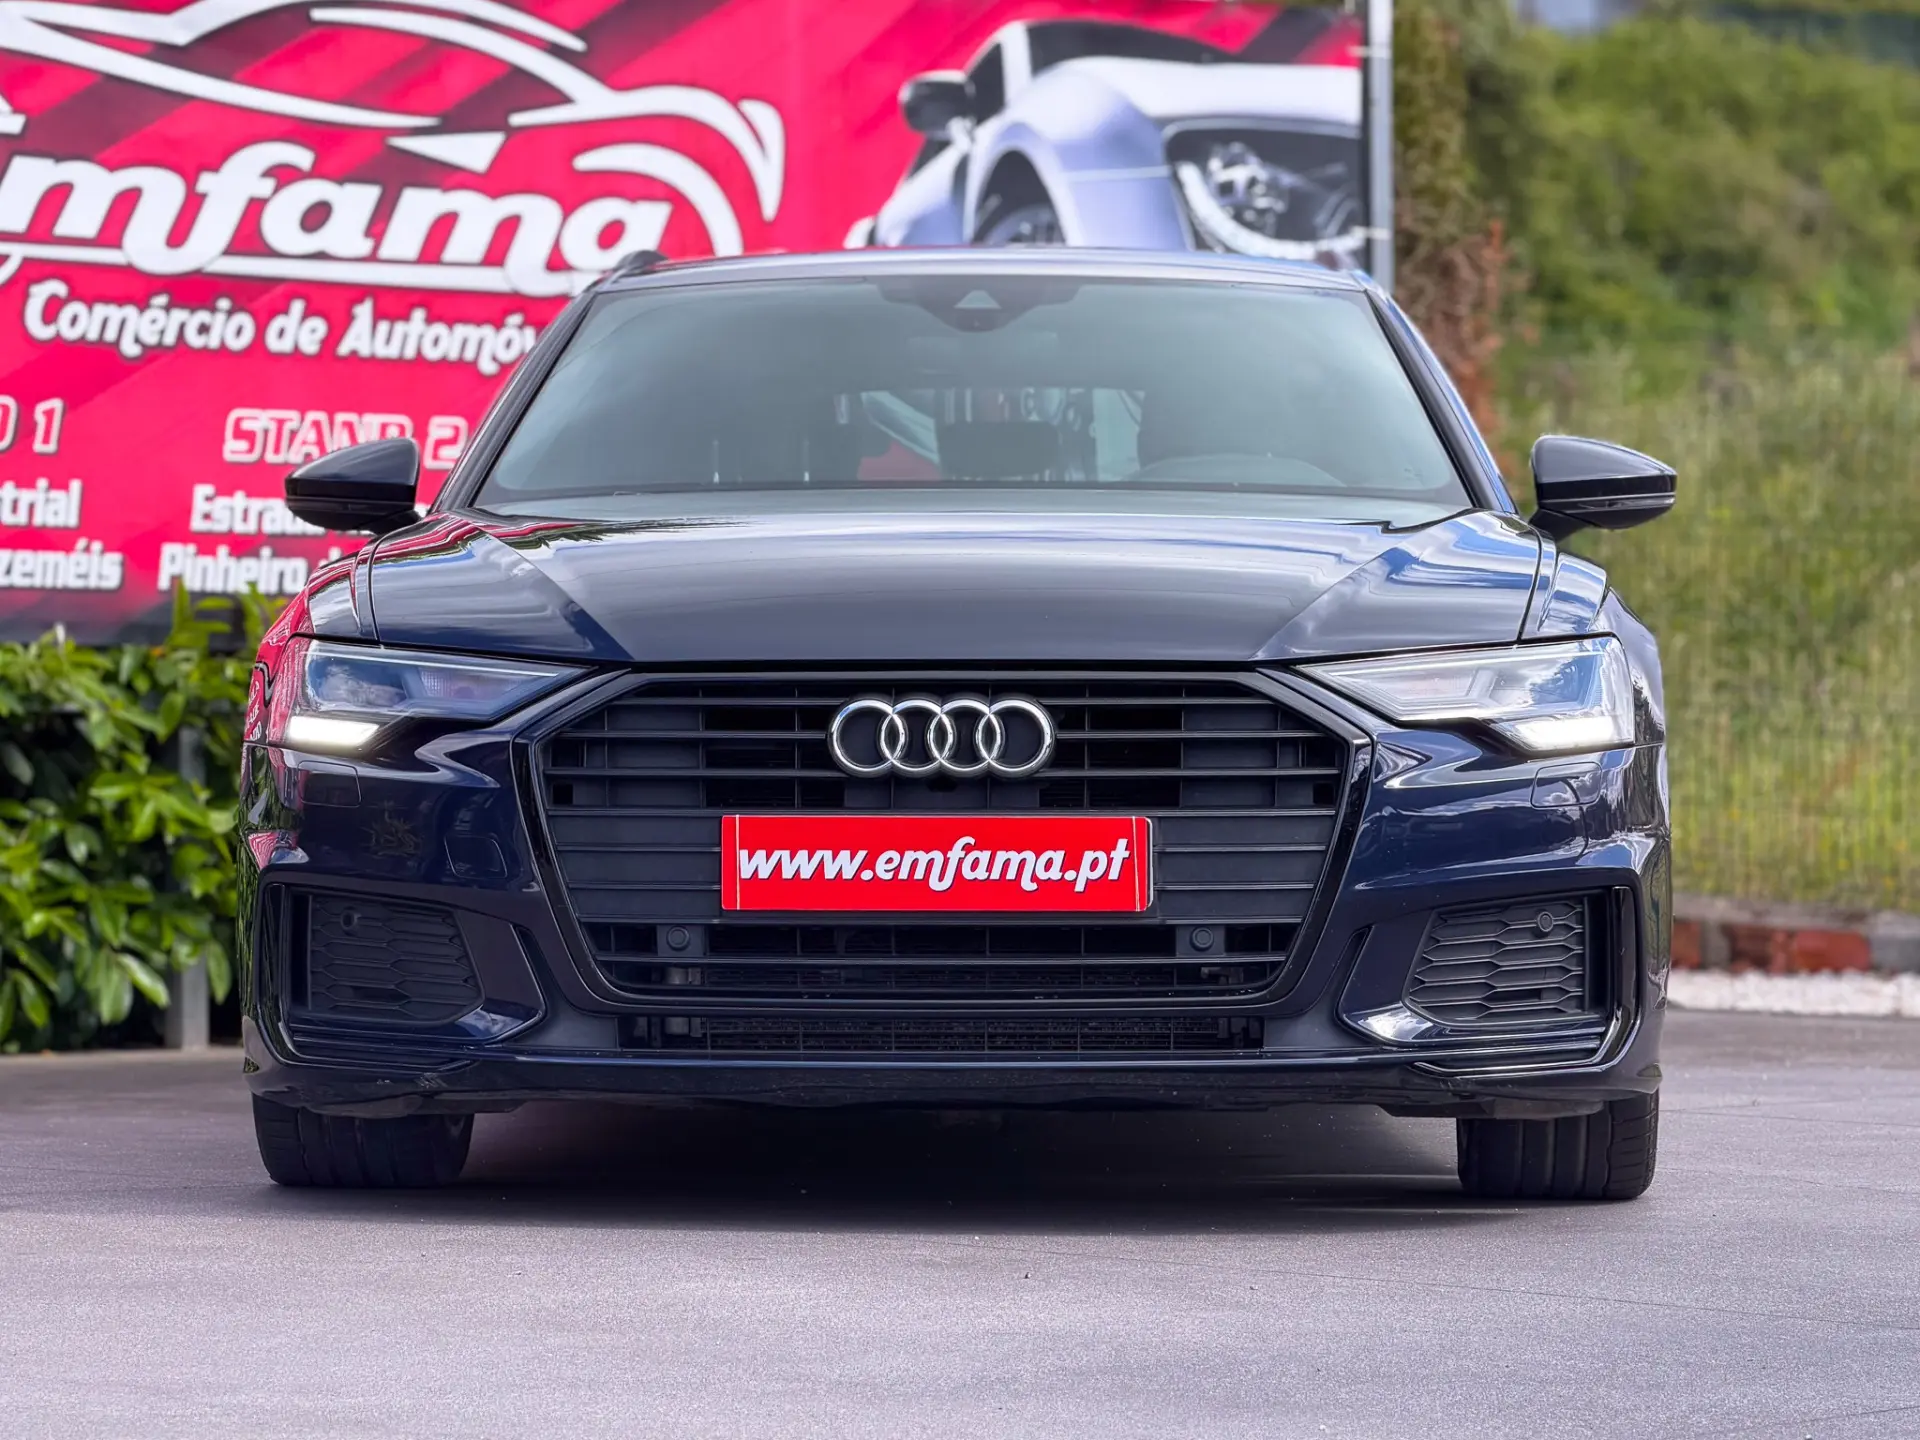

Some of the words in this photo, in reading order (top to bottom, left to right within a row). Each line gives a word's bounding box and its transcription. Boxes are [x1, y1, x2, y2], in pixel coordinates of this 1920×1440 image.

[23, 278, 257, 358] Comércio
[264, 298, 329, 355] de
[33, 397, 65, 453] 1
[423, 415, 469, 470] 2
[0, 477, 82, 528] trial
[157, 542, 308, 594] Pinheiro
[739, 836, 1130, 893] www.emfama.pt
